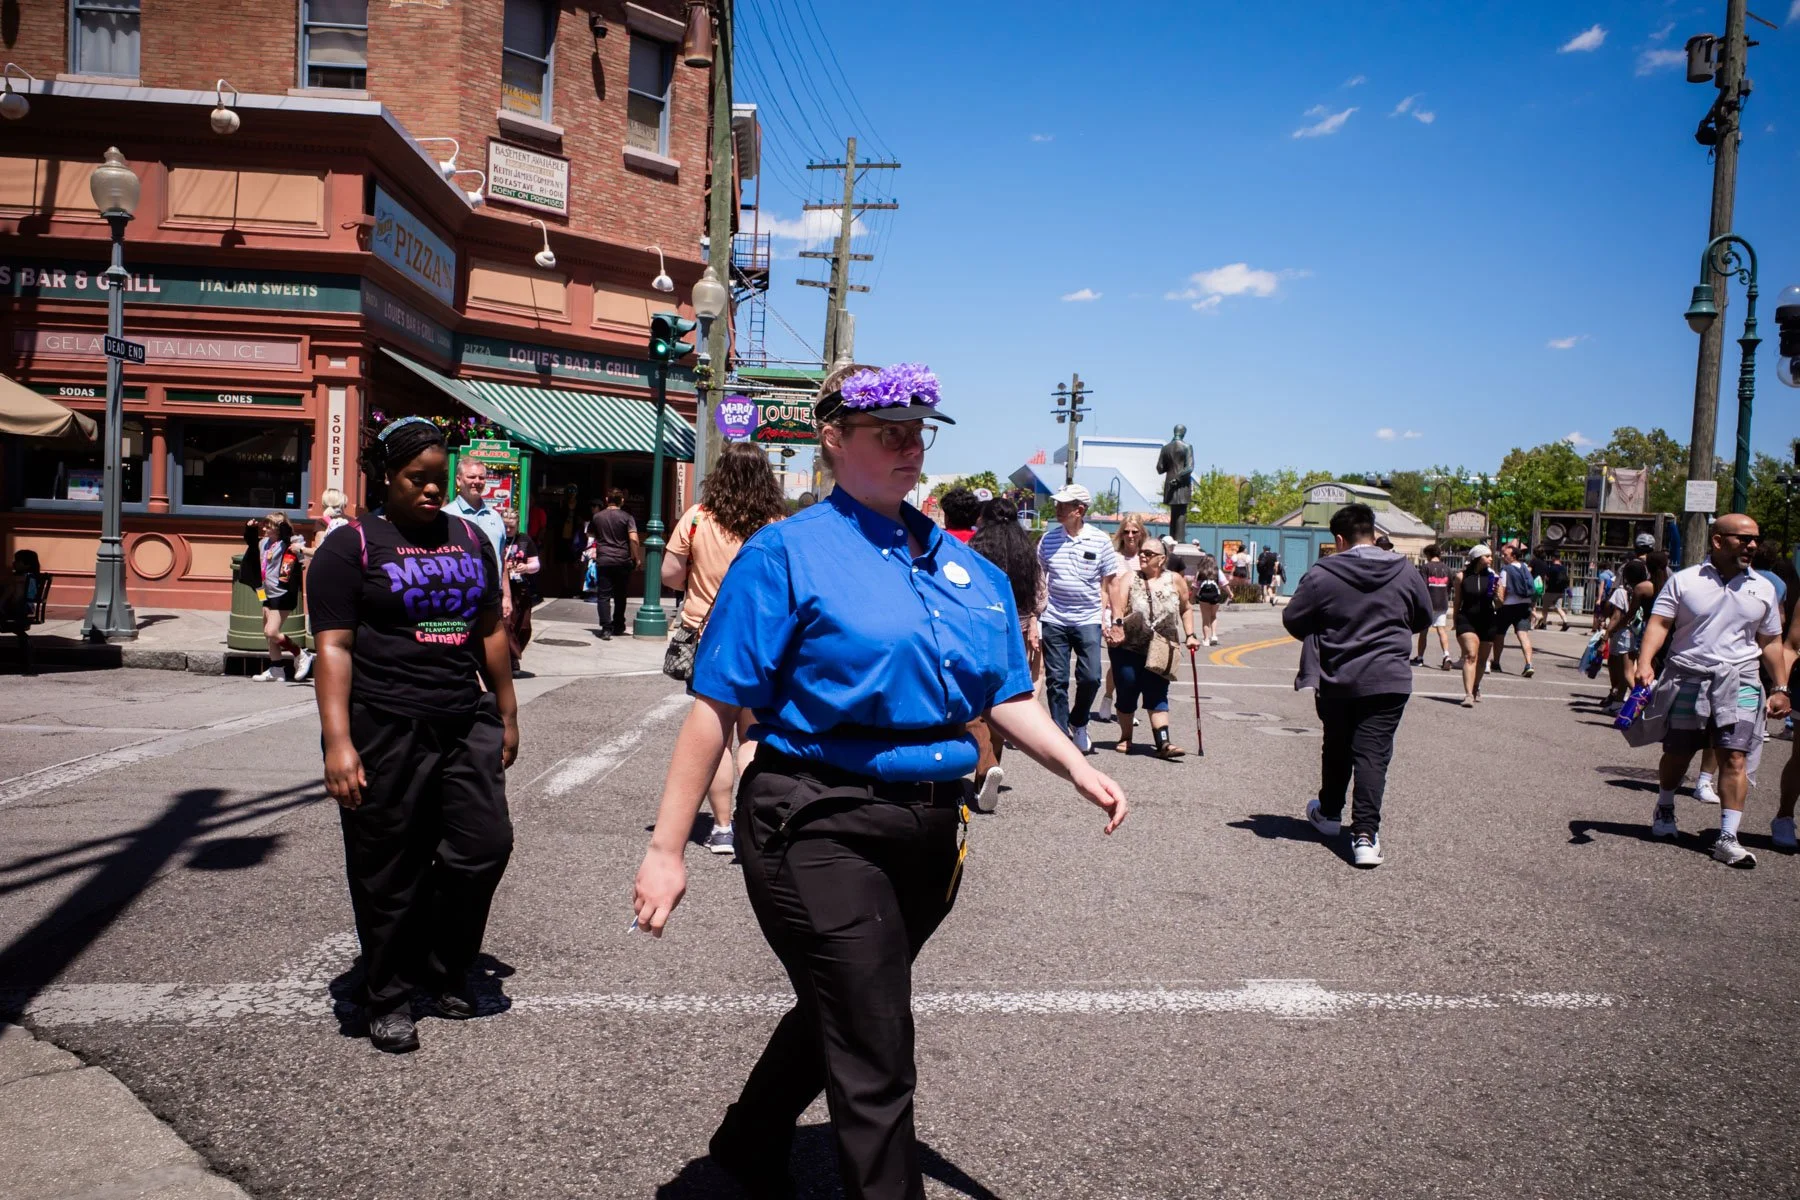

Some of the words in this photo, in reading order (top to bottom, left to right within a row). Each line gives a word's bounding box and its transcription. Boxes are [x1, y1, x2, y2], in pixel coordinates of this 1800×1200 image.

[495, 146, 530, 163] BASEMENT
[532, 156, 565, 172] AVAILABLE
[493, 164, 513, 177] KEITH
[514, 170, 533, 182] JAMES
[533, 175, 565, 190] COMPANY
[504, 177, 522, 189] EAST
[492, 185, 516, 197] AGENT
[517, 191, 529, 200] ON
[530, 195, 565, 209] PREMISES
[21, 267, 67, 288] BAR
[74, 270, 88, 290] &
[96, 272, 161, 293] GILL
[200, 278, 257, 294] ITALIAN
[261, 281, 318, 298] SWEETS
[45, 335, 105, 351] GELA
[147, 340, 222, 358] ITALIAN
[232, 344, 266, 360] ICE
[107, 339, 126, 355] DEAD
[128, 344, 144, 360] END
[464, 343, 492, 356] PIZZA
[509, 347, 560, 368] LOUIE'S
[565, 355, 591, 372] BAR
[594, 358, 602, 373] &
[606, 362, 641, 379] GRILL
[655, 370, 685, 383] SADS
[59, 386, 95, 397] SODAS
[217, 393, 253, 404] CONES
[332, 414, 341, 476] SORBET
[469, 449, 511, 459] GELATO
